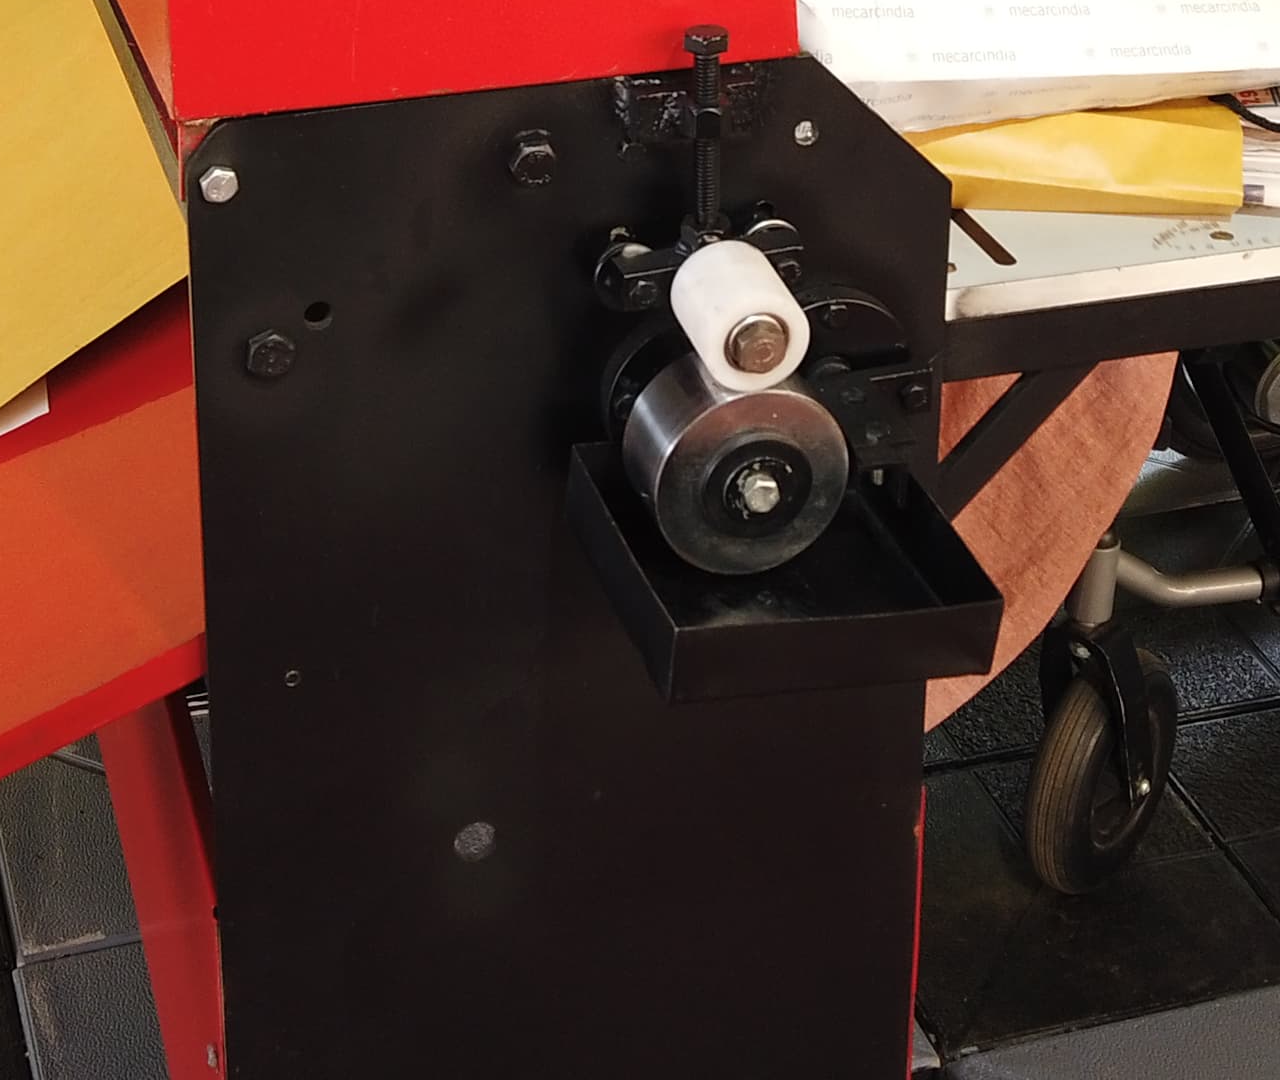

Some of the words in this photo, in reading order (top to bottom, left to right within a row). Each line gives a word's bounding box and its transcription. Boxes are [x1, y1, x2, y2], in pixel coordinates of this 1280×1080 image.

[831, 5, 915, 19] mecarcindia
[1008, 2, 1091, 17] mecarcindia
[1180, 0, 1261, 14] mecarcindia
[932, 48, 1017, 63] mecarcindia
[1110, 43, 1192, 58] mecarcindia
